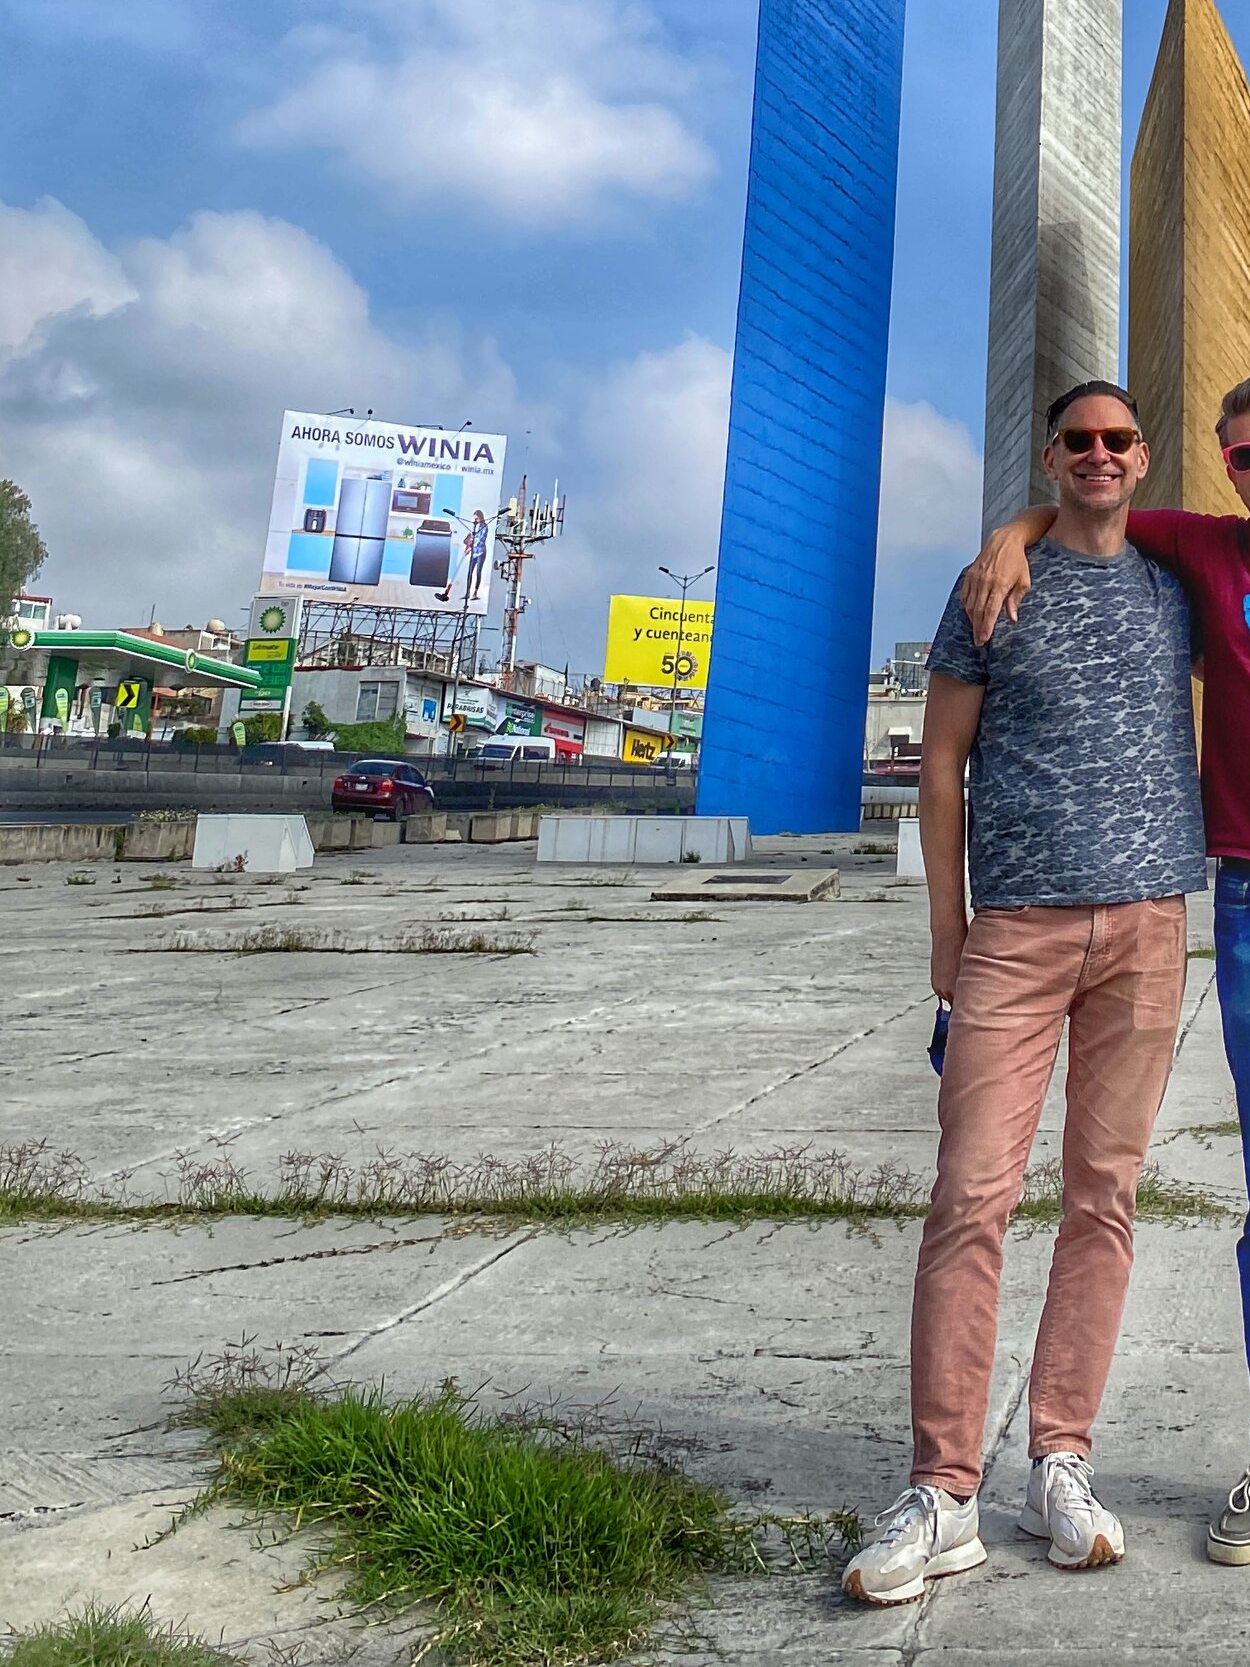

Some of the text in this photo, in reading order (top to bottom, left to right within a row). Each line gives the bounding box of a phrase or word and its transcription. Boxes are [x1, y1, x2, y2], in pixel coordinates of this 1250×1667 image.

[291, 426, 495, 464] AHORA SOMOS WINIA
[397, 457, 495, 475] @winiamexico winia.mx
[633, 628, 712, 642] y cuentean
[661, 655, 693, 675] 50
[630, 738, 656, 761] Hertz
